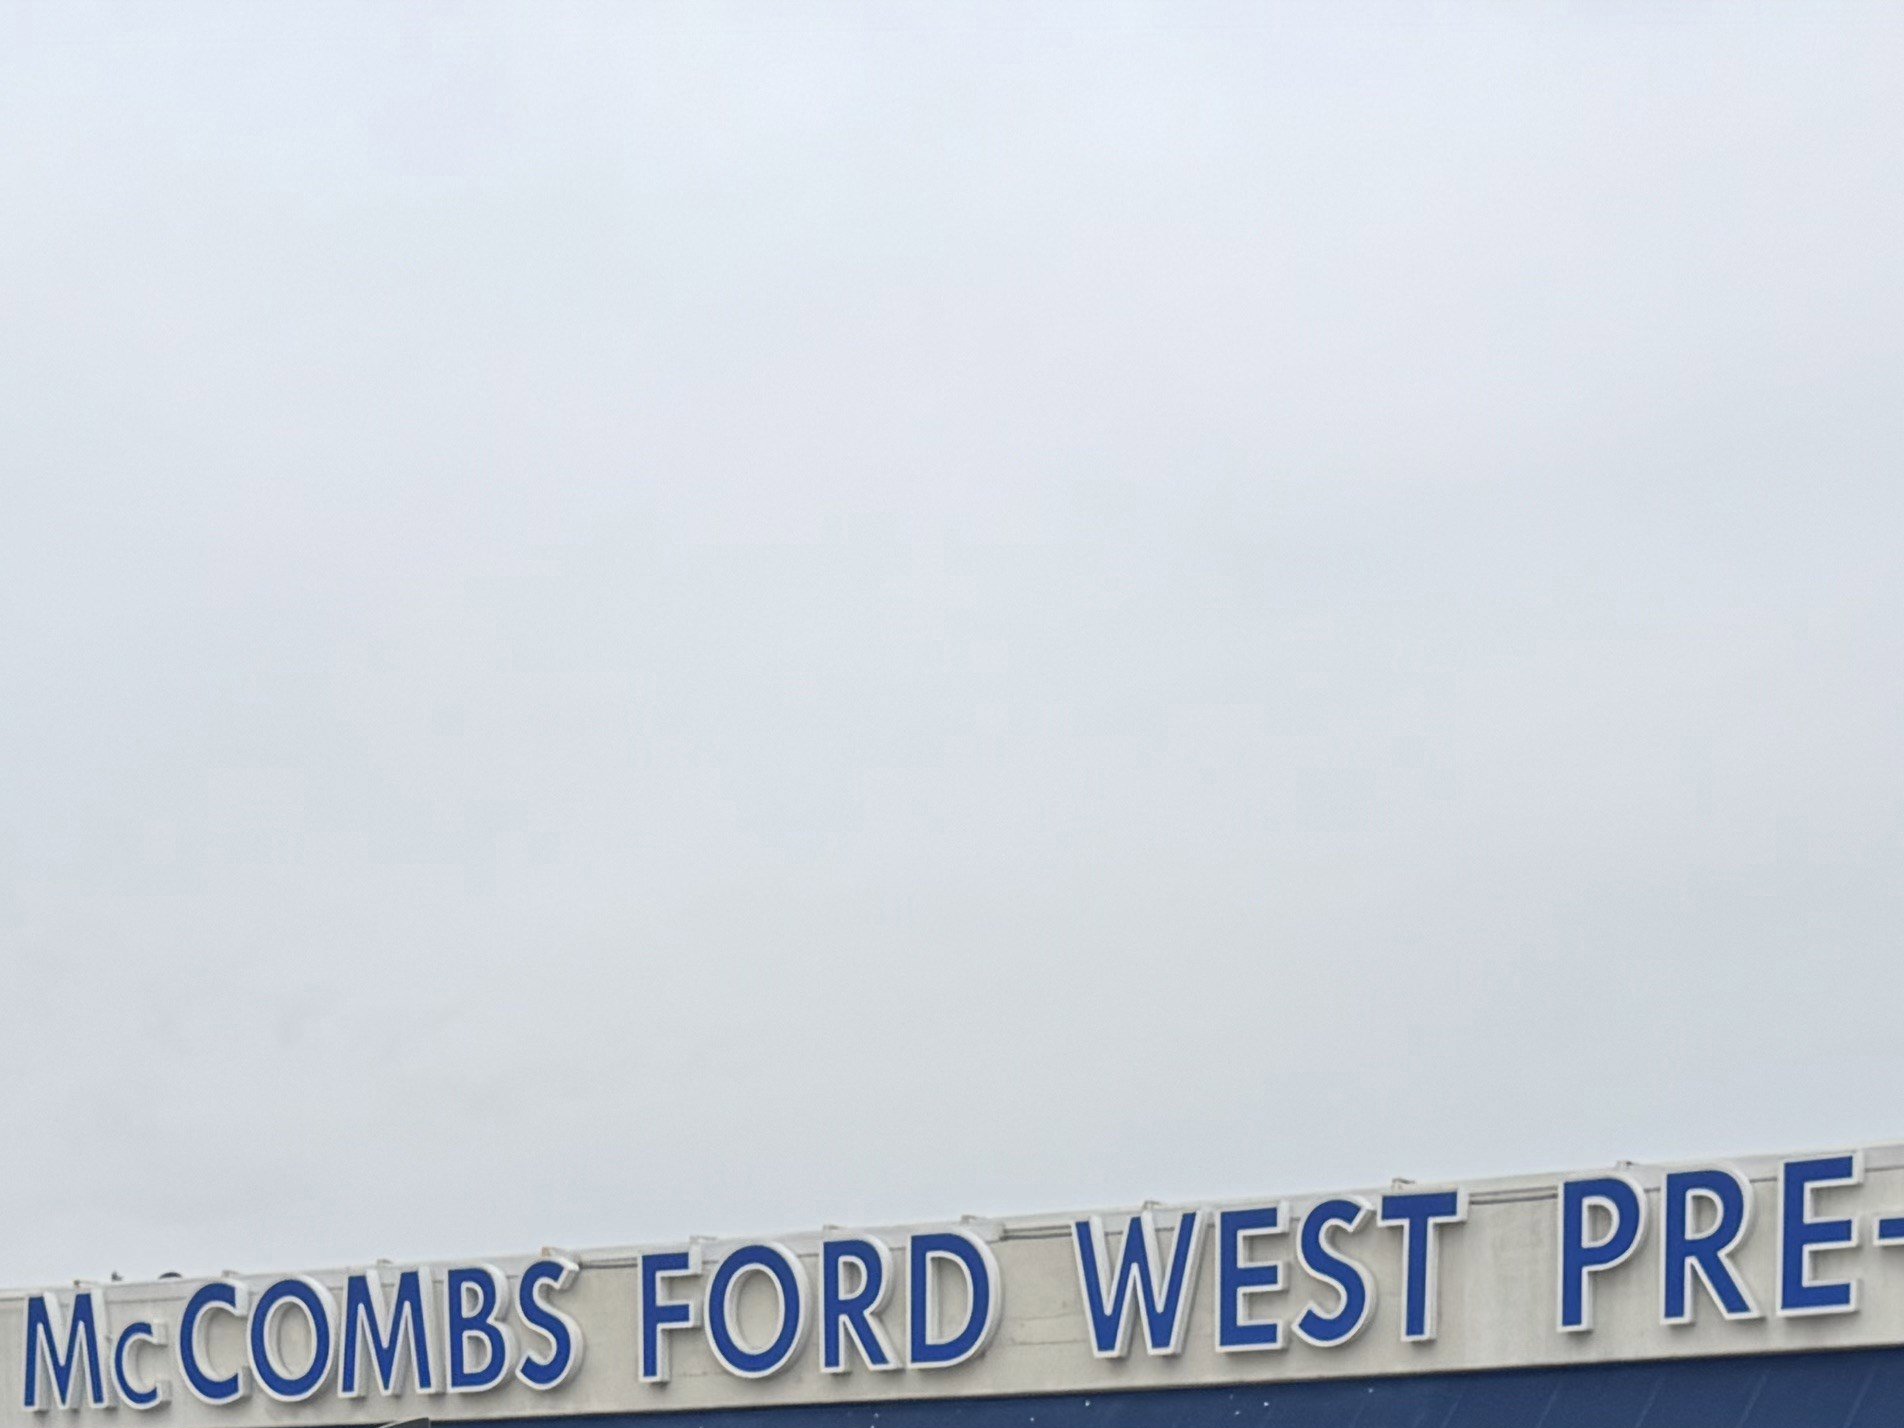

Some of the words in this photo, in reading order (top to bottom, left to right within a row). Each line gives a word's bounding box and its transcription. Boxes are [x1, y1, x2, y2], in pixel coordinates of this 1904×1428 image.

[23, 1258, 575, 1409] McCOMBS
[640, 1232, 993, 1380] FORD
[1073, 1190, 1461, 1354] WEST
